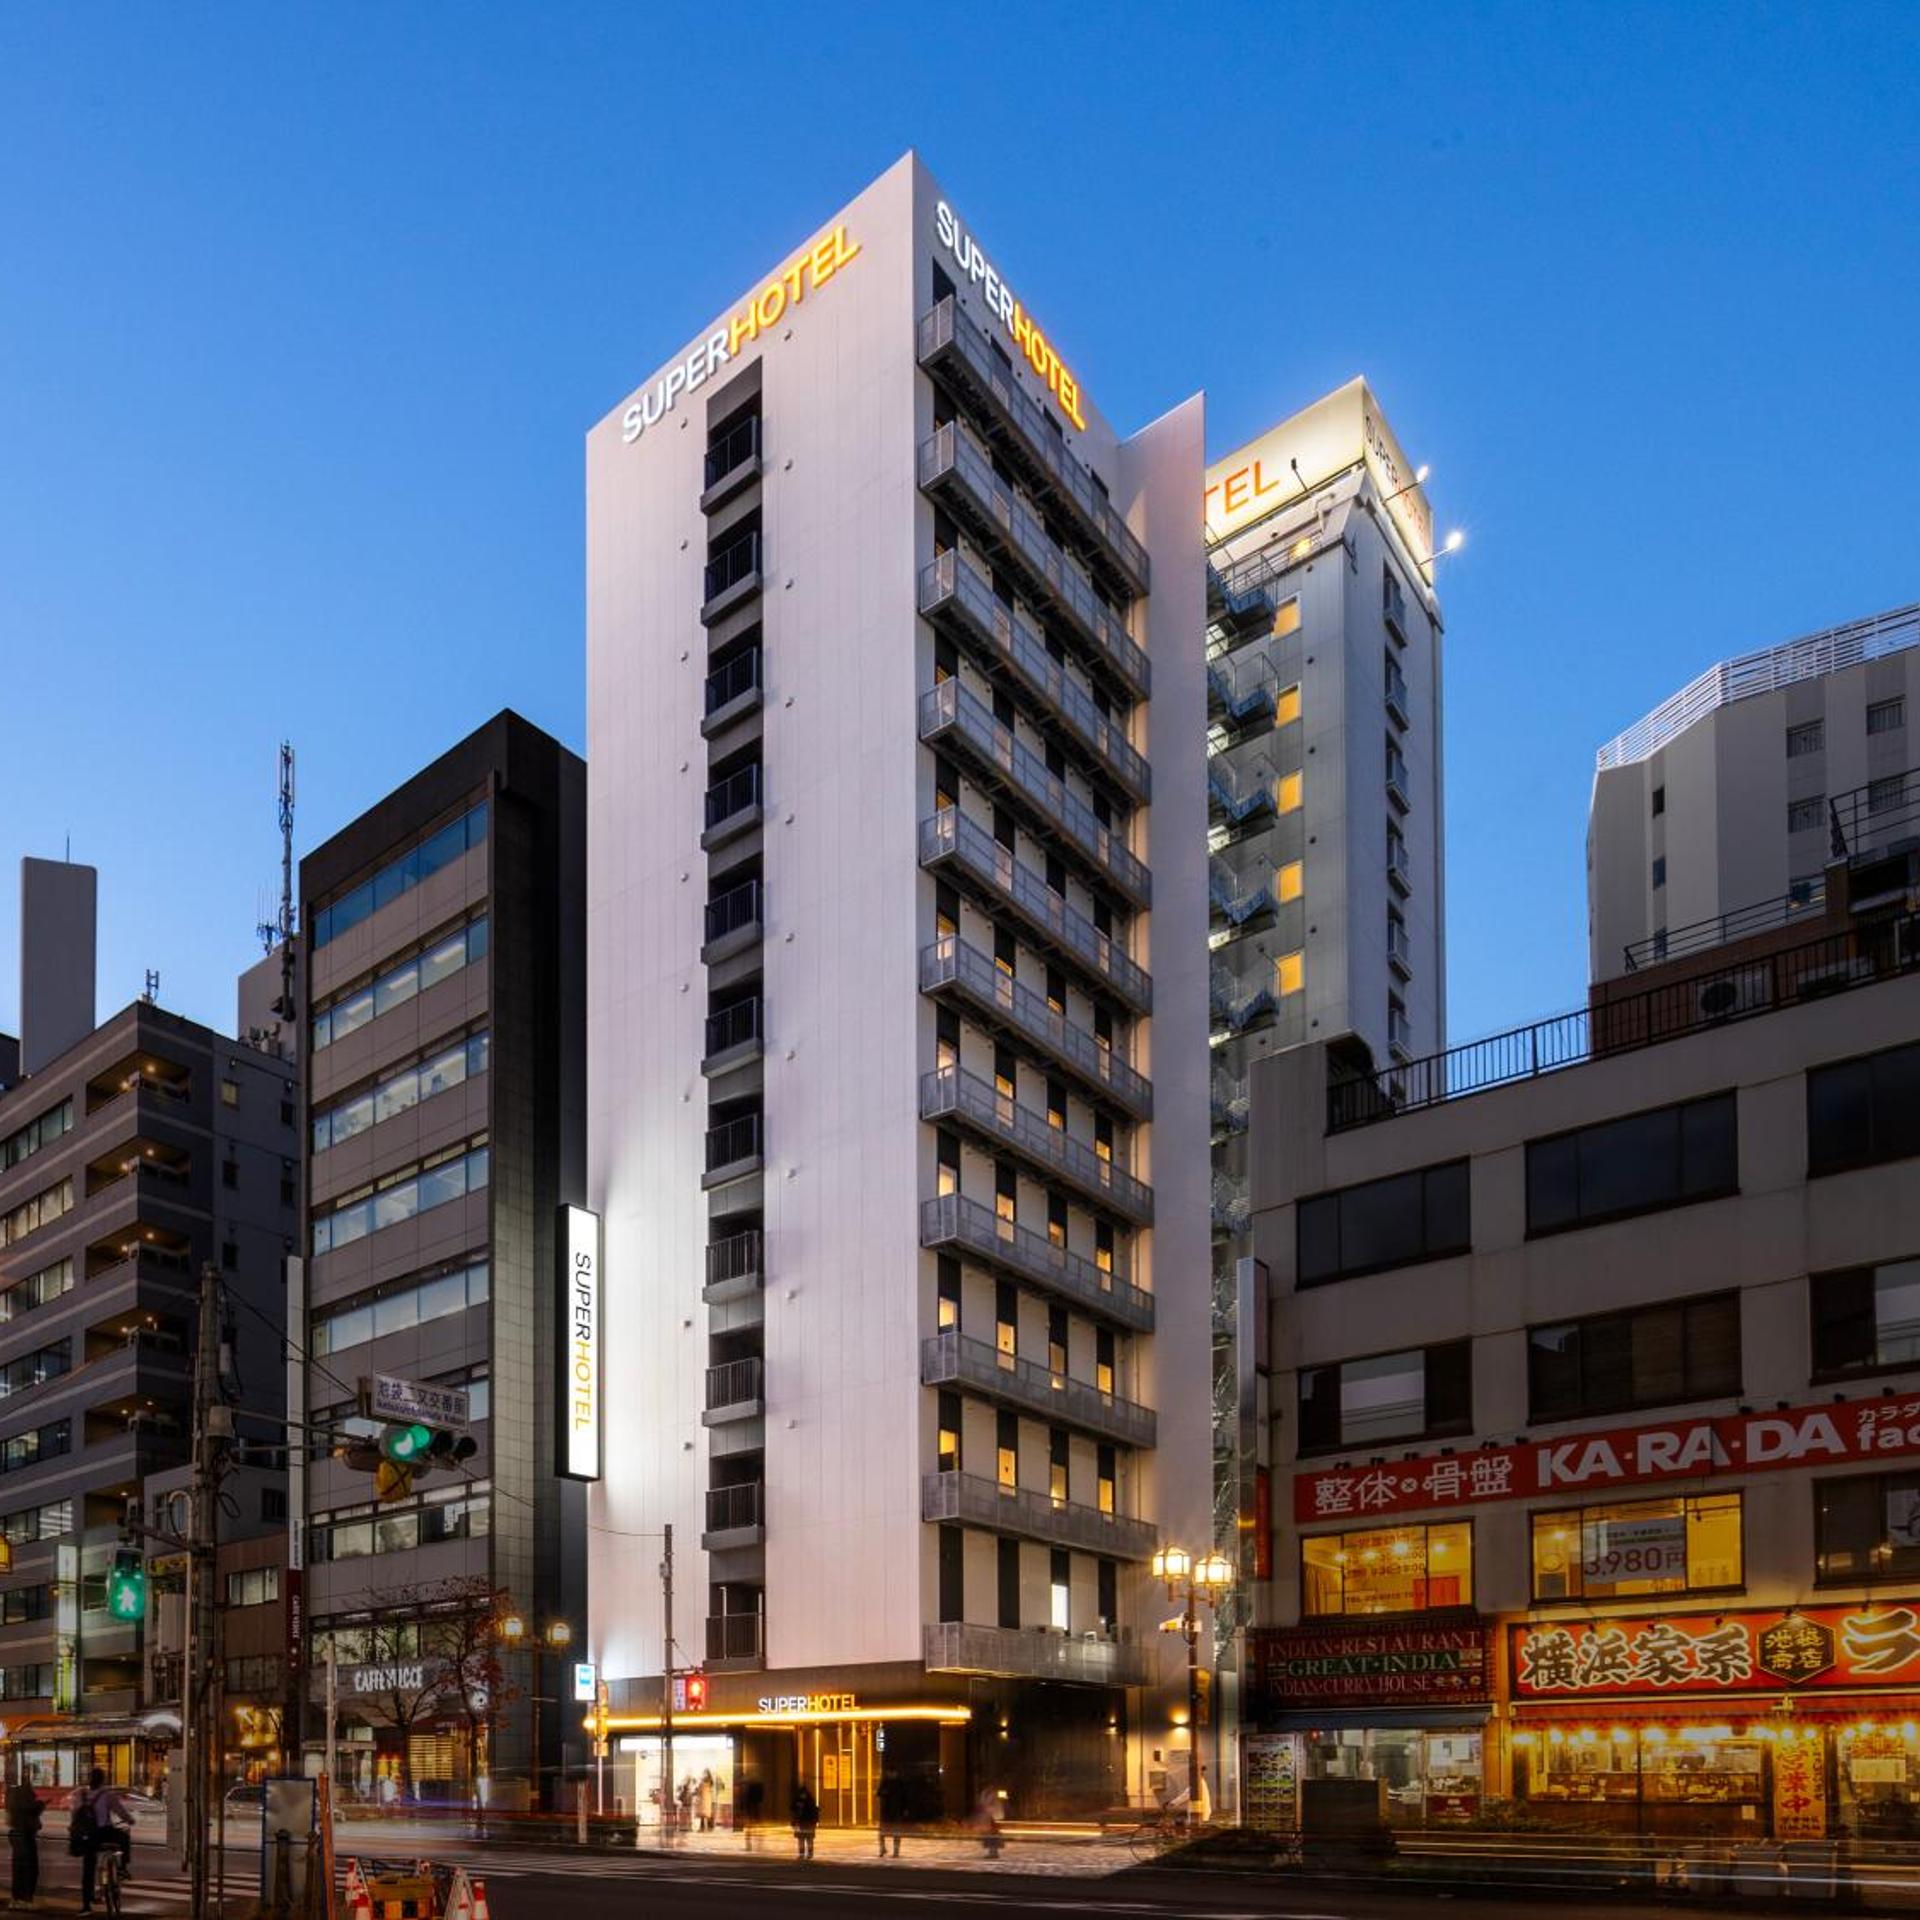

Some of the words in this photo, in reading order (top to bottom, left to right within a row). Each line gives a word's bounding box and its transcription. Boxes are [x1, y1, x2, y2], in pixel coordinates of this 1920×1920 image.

[623, 225, 861, 443] SUPERHOTEL
[936, 201, 1086, 431] SUPERHOTEL
[575, 1252, 592, 1431] SUPERHOTEL
[758, 1694, 861, 1713] SUPERHOTEL
[1378, 1675, 1432, 1692] HOUSE
[1519, 1623, 1752, 1689] 横浜家系
